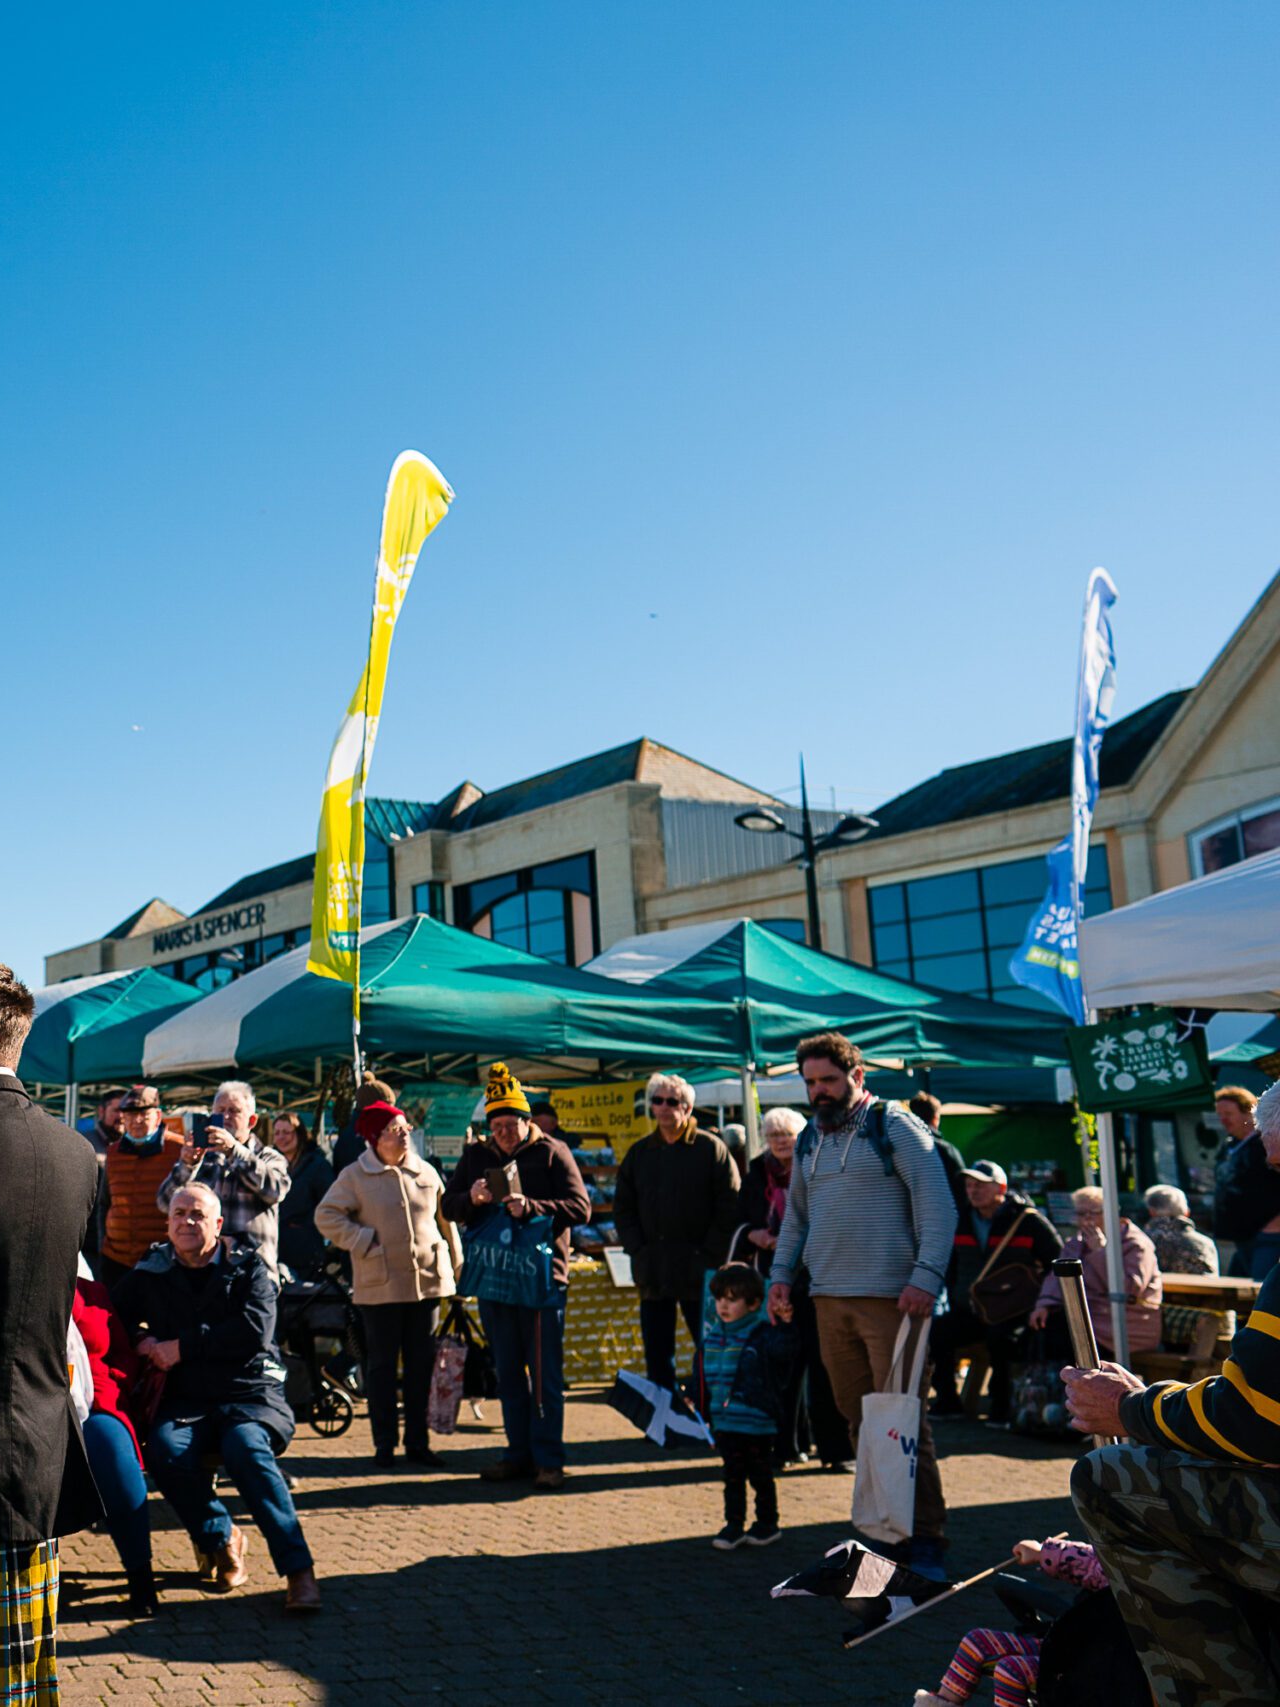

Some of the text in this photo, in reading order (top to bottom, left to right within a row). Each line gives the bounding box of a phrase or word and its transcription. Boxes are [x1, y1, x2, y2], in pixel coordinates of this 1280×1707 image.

[153, 924, 192, 954] MARKS
[204, 902, 266, 940] SPENCER
[1119, 1041, 1162, 1056] TRURO
[581, 1091, 624, 1108] Little
[608, 1113, 631, 1129] Dog
[467, 1243, 537, 1276] PAVERS
